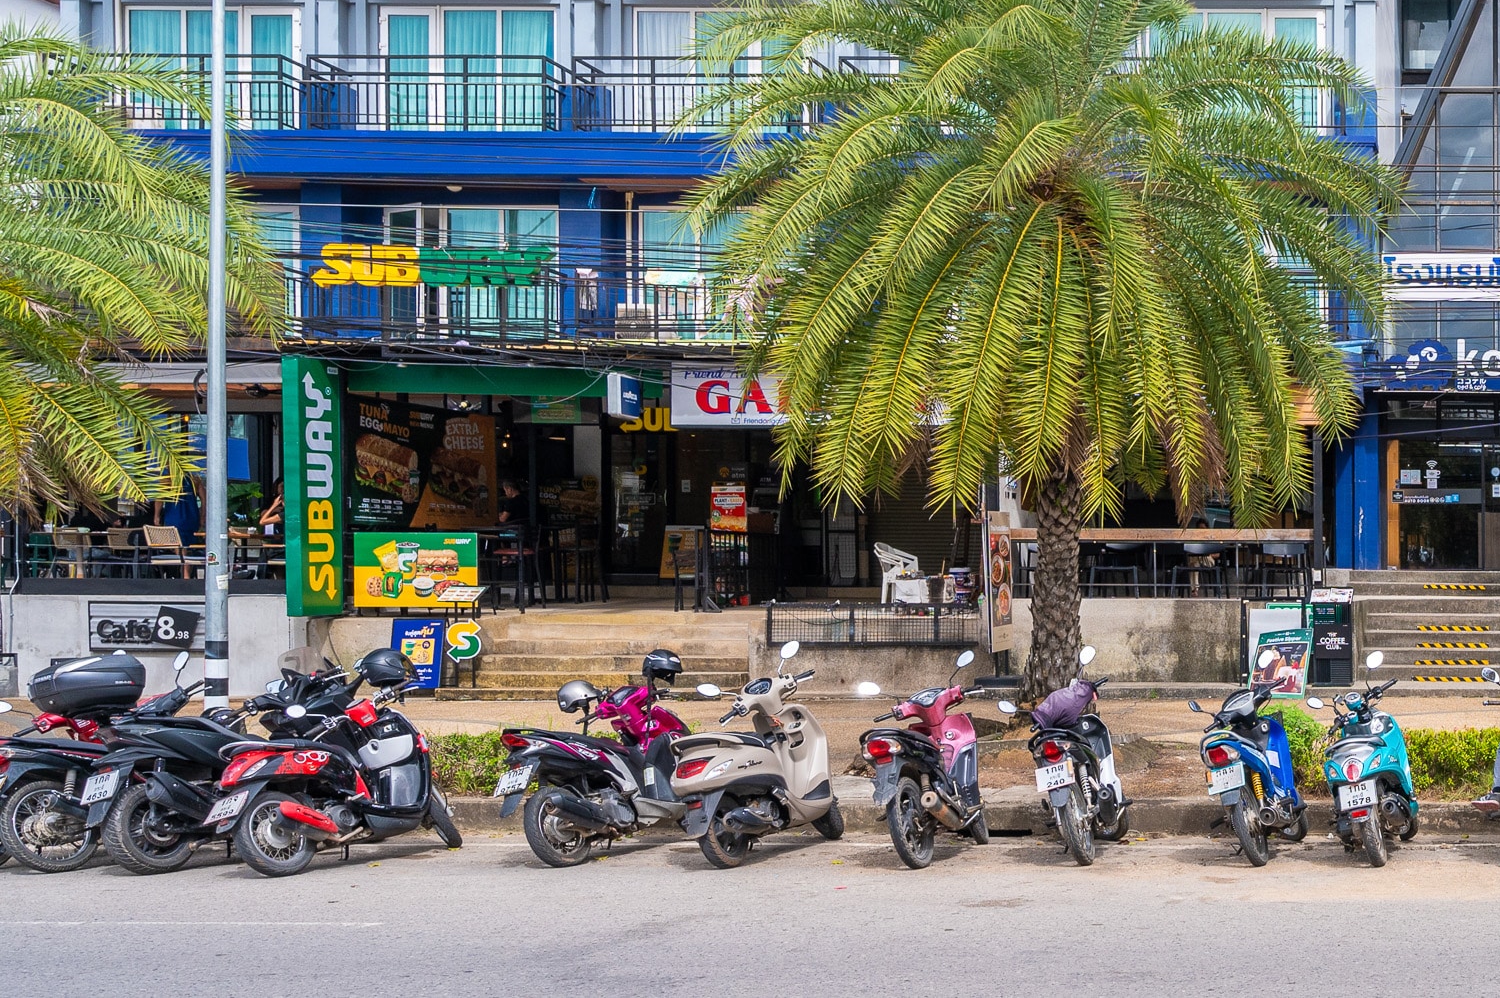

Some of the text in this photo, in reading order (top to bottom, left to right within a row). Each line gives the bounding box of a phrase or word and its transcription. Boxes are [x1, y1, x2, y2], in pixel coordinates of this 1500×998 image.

[311, 243, 557, 288] SUBWAY
[359, 403, 389, 421] TUNA
[446, 423, 480, 436] EXTRA
[444, 435, 485, 450] CHEESE
[302, 371, 337, 601] SUBWAY
[96, 617, 151, 639] Café
[1320, 637, 1346, 645] COFFEE
[1046, 778, 1065, 788] 240
[86, 790, 108, 801] 4630
[1347, 796, 1372, 807] 1578
